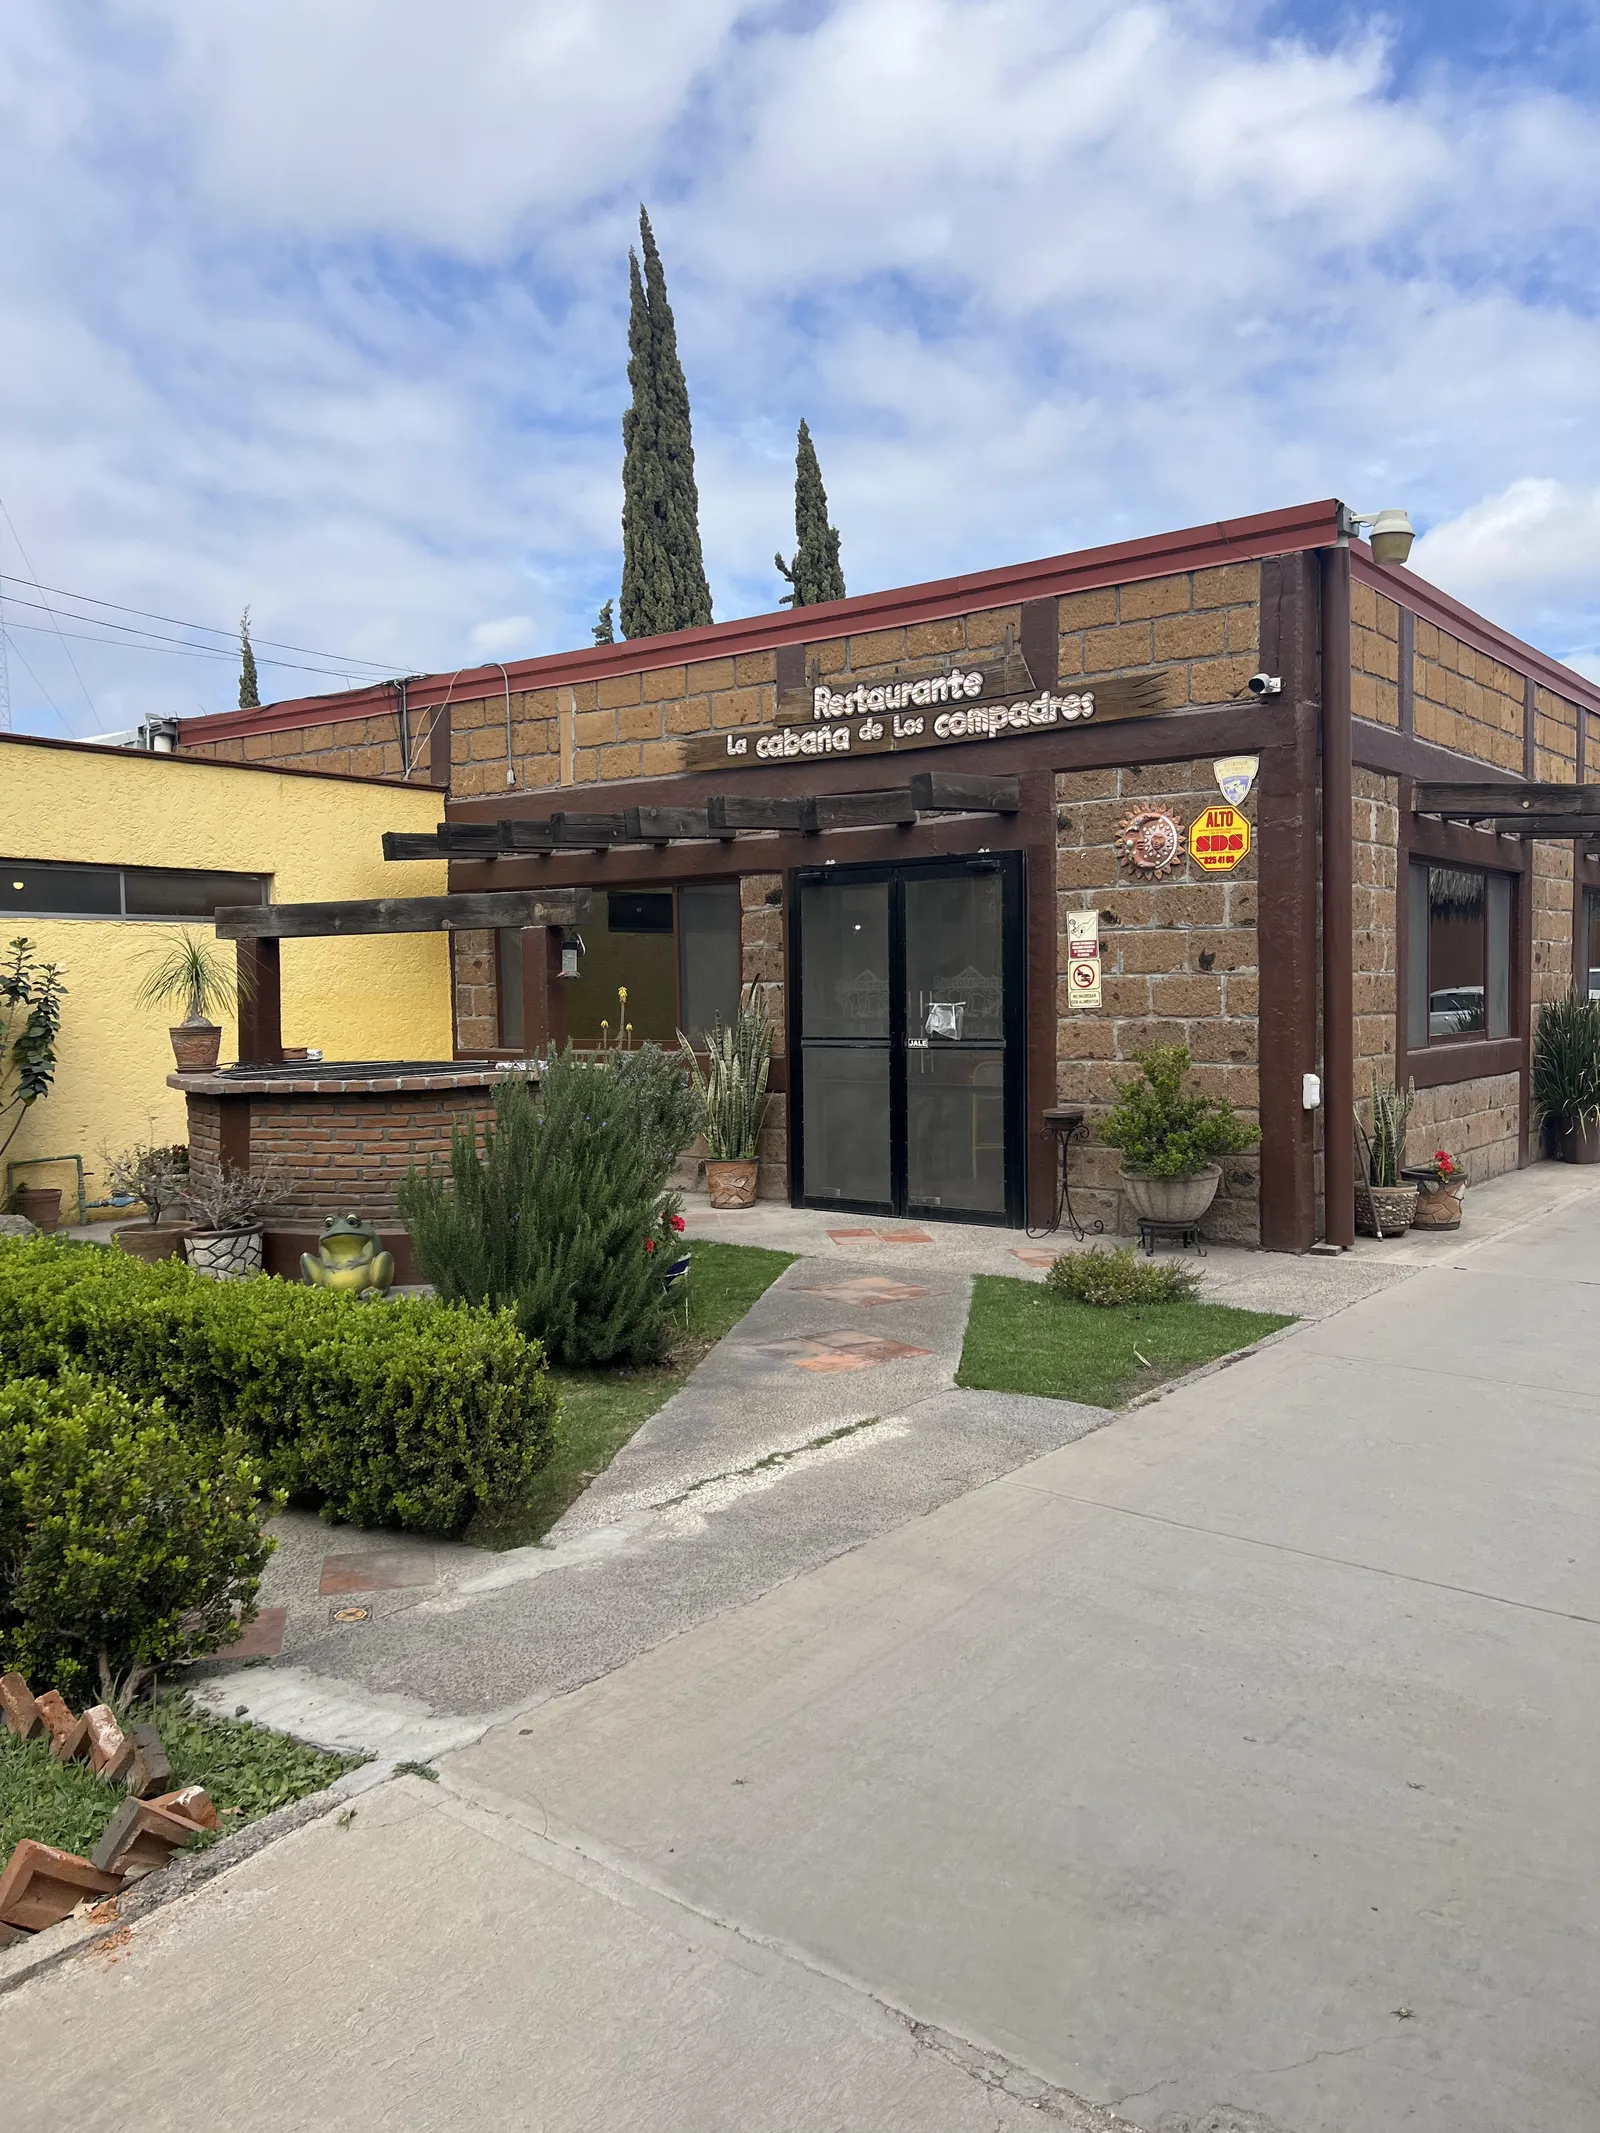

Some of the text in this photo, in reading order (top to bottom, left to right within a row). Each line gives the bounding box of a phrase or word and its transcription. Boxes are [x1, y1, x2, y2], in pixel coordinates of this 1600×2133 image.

[812, 668, 984, 721] Restaurante
[726, 733, 748, 756] La
[755, 724, 851, 759] cabaña
[858, 717, 884, 741] de
[933, 690, 1096, 739] compadres
[1206, 811, 1233, 828] ALTO
[1196, 834, 1243, 852] SDS
